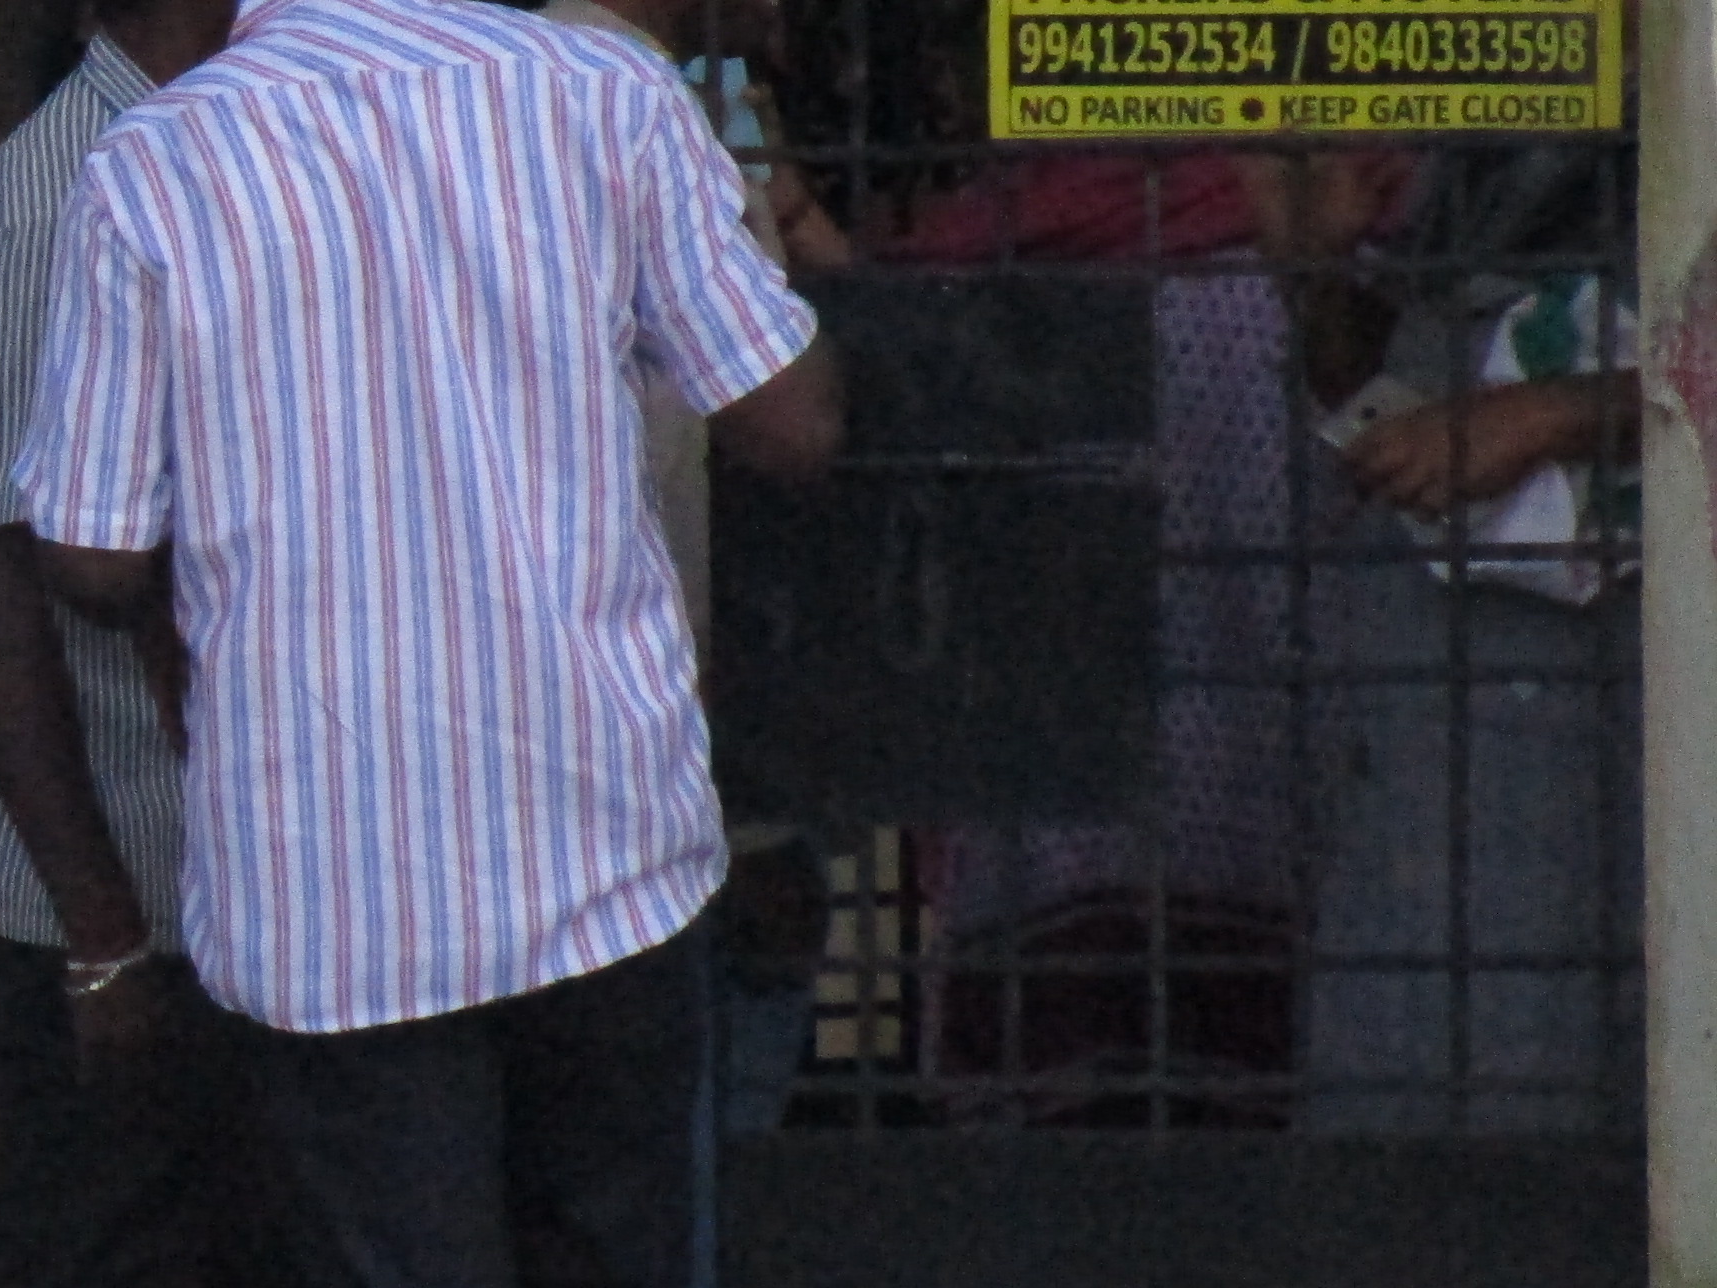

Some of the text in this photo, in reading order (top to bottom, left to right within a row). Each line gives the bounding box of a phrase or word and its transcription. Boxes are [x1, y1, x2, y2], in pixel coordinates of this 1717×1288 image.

[1018, 20, 1276, 74] 9941252534
[1327, 18, 1587, 73] 9840333598
[1019, 93, 1587, 126] NO PARKING KEEP GATE CLOSED
